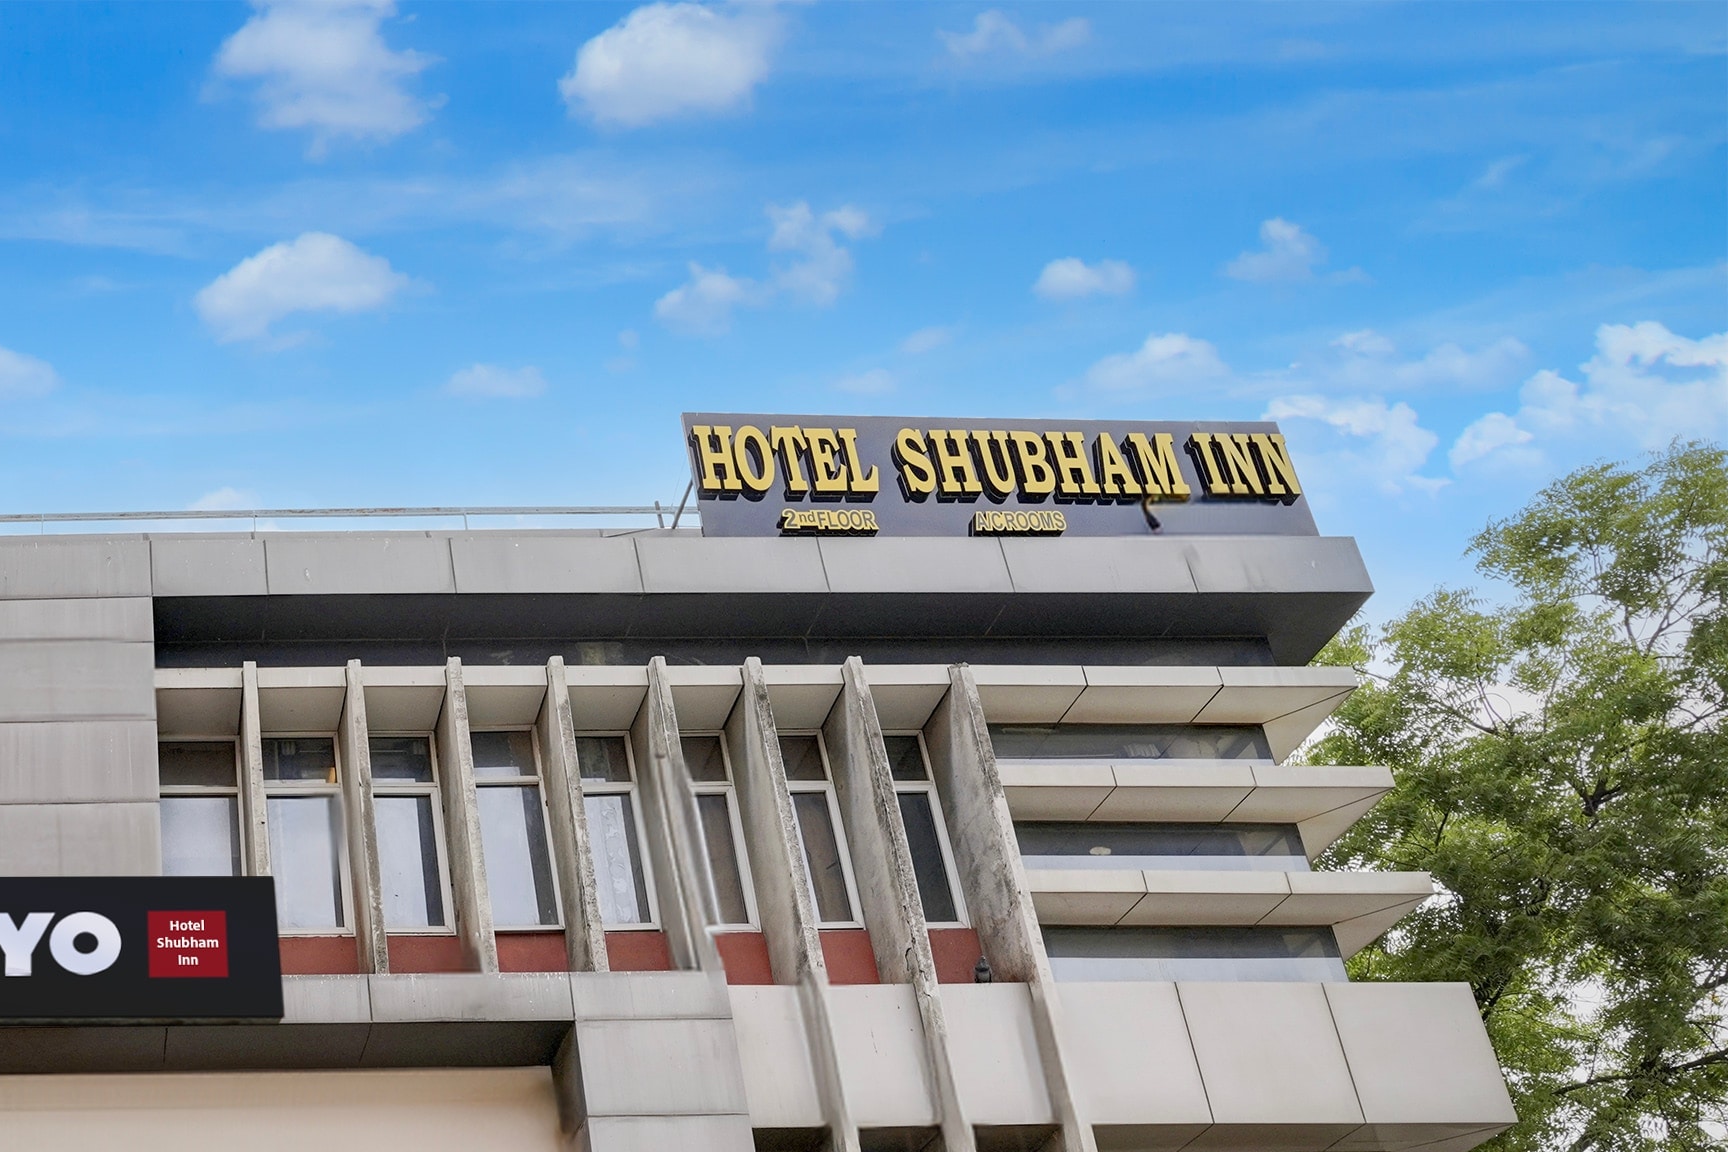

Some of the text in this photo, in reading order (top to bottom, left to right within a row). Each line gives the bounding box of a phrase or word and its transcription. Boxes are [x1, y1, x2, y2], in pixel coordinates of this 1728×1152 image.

[690, 424, 1301, 503] HOTEL SHUBHAM INN
[169, 919, 205, 932] Hotel
[156, 936, 219, 949] Shubham
[177, 954, 199, 966] Inn
